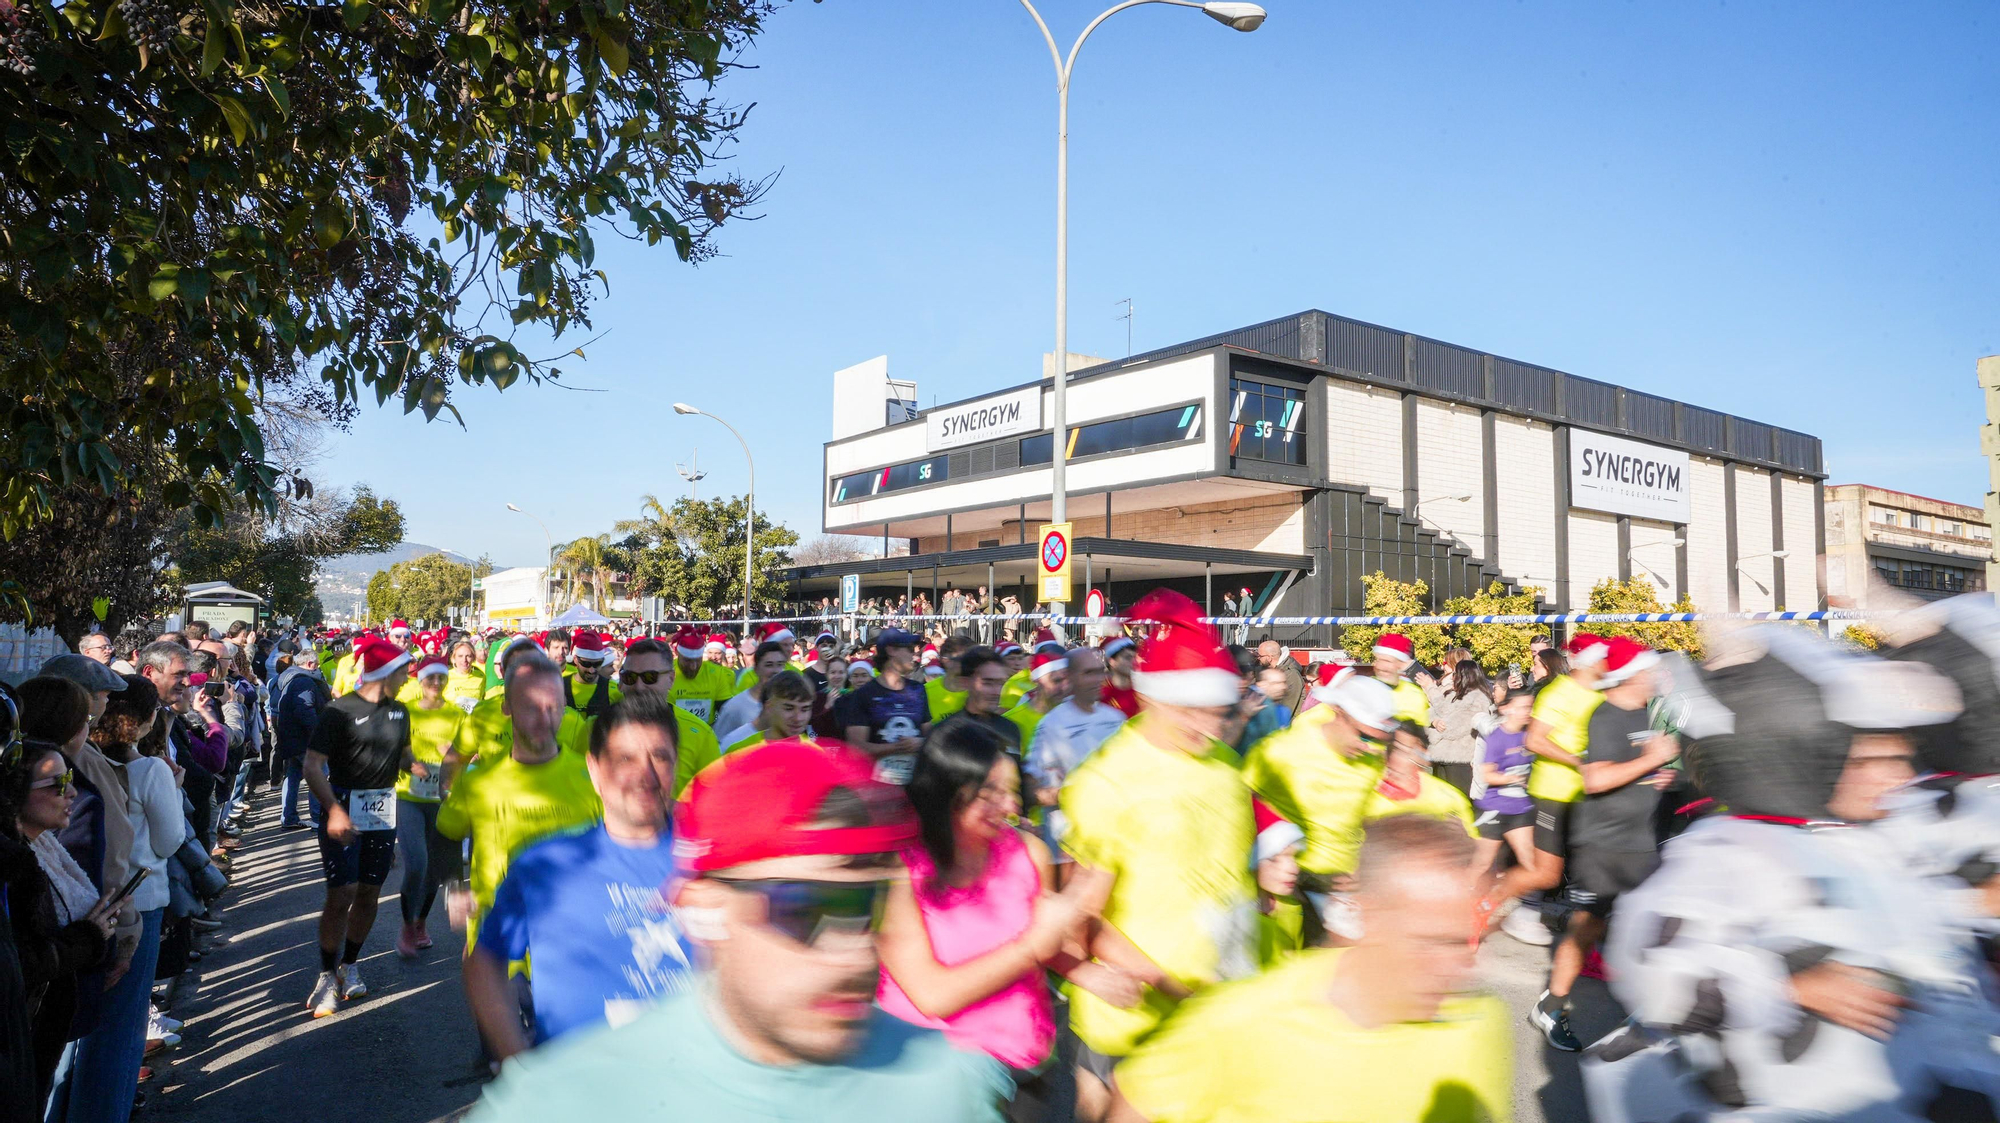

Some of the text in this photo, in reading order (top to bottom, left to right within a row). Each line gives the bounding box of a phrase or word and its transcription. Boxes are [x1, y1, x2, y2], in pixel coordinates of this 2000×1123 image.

[942, 401, 1020, 437] SYNERGYM
[1254, 420, 1273, 438] SG
[919, 464, 932, 479] SG
[1582, 448, 1680, 492] SYNERGYM
[1620, 488, 1661, 501] TOGETHER
[845, 579, 855, 608] P
[361, 800, 385, 813] 442
